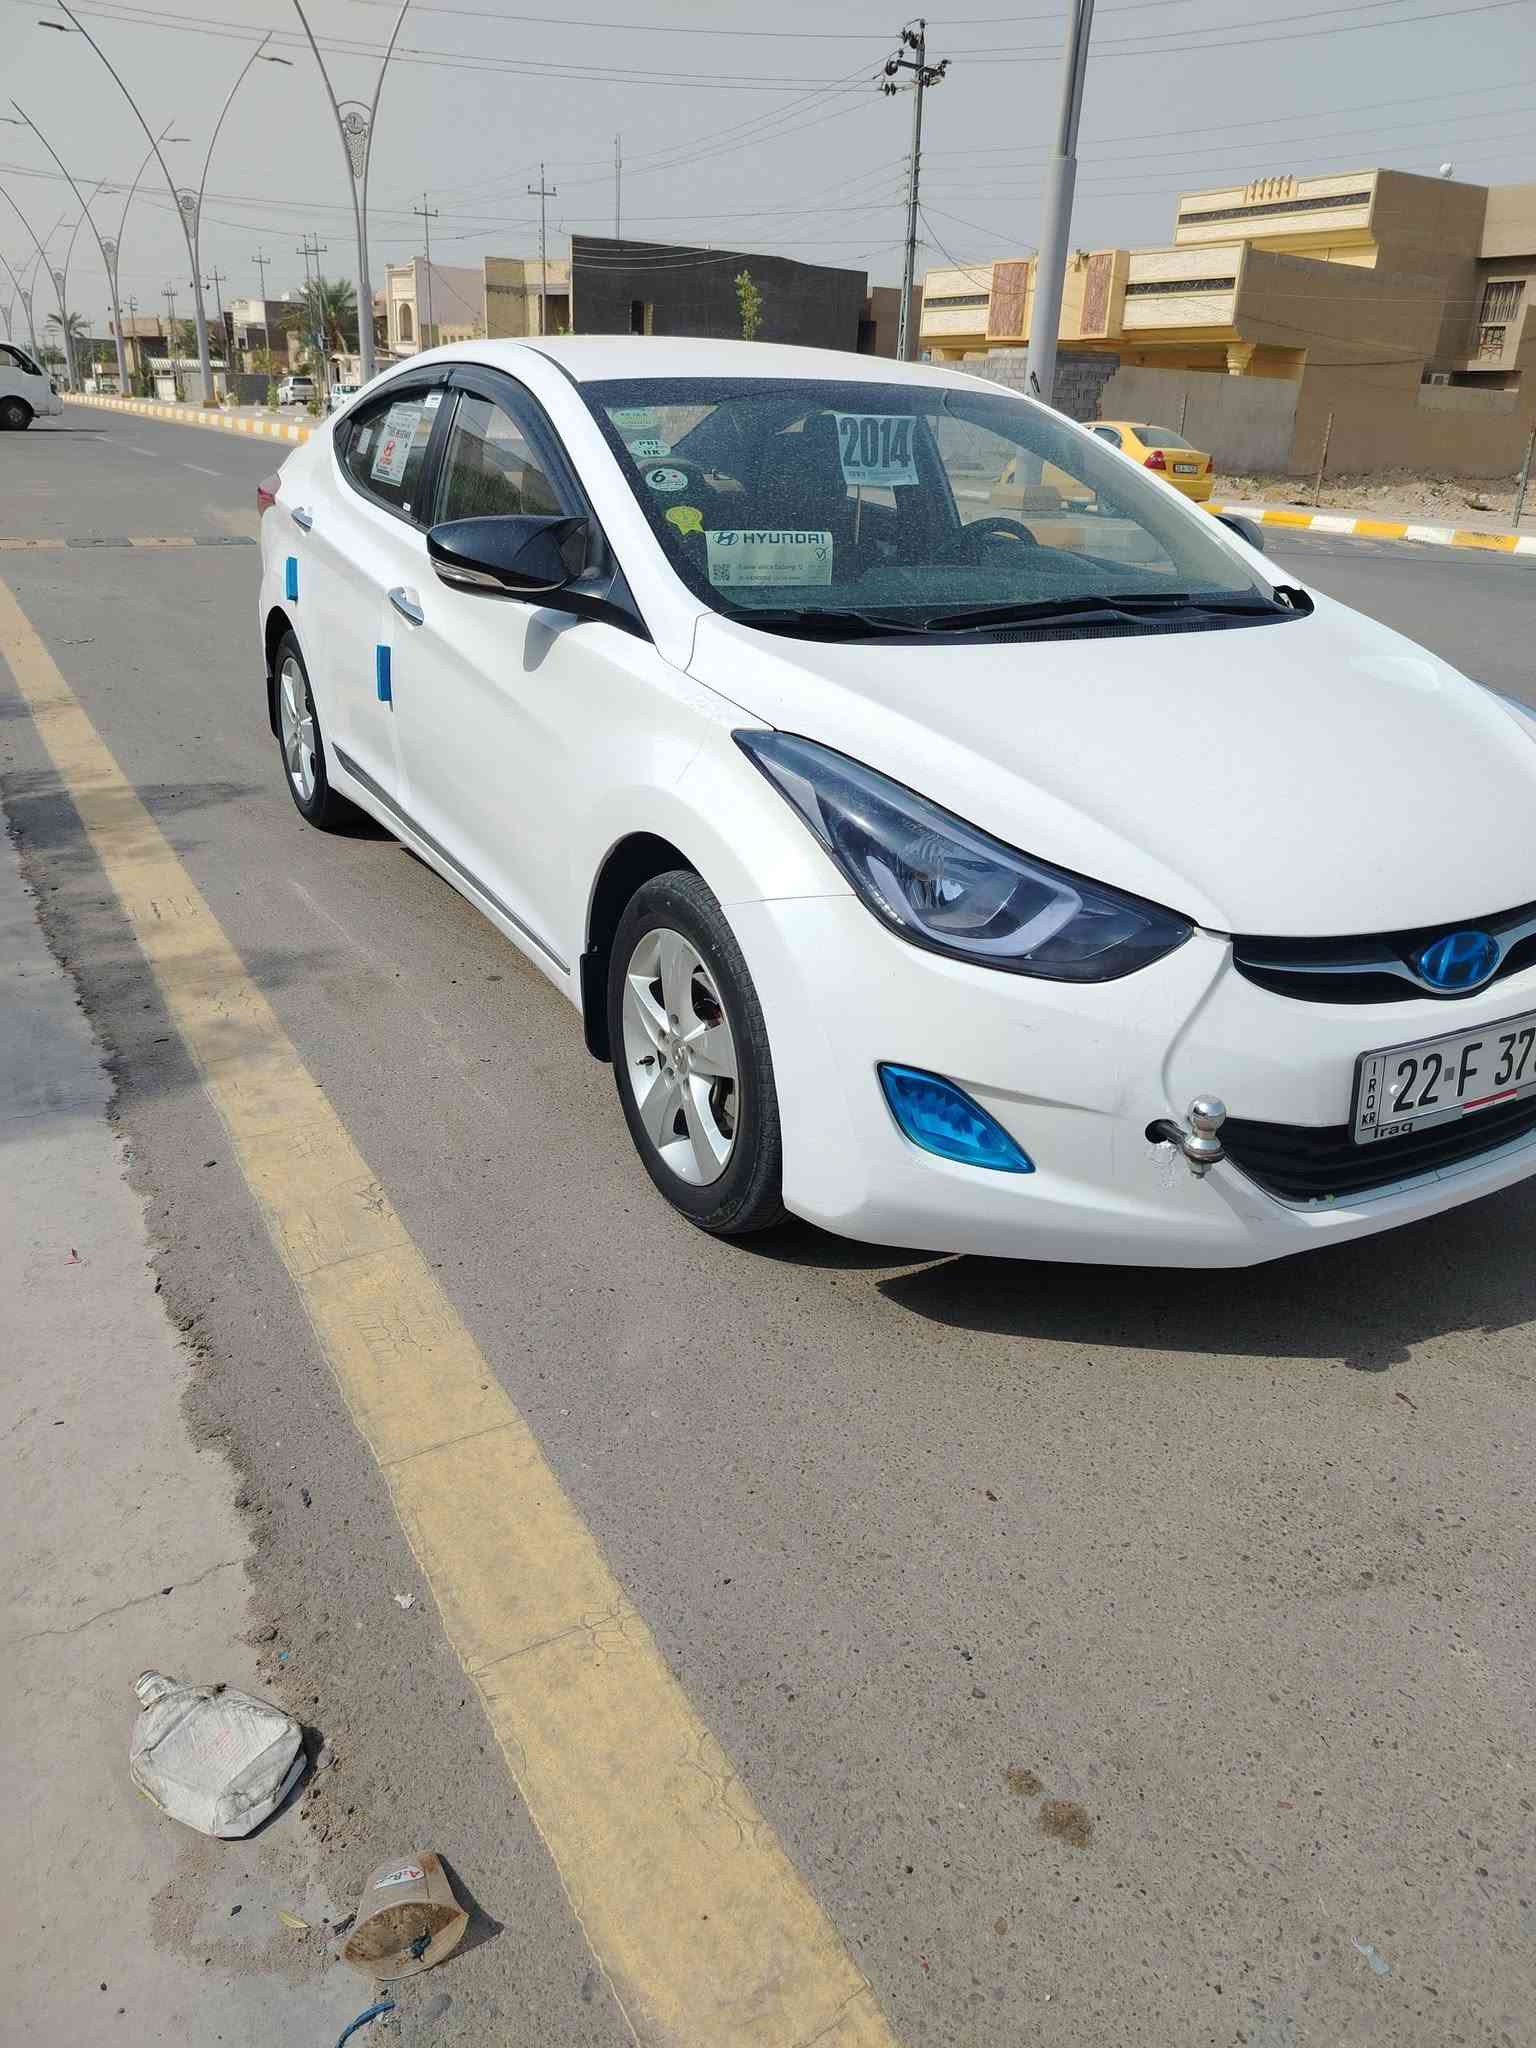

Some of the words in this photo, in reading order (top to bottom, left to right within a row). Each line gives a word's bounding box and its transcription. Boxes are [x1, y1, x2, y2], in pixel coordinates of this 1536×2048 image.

[840, 416, 912, 468] 2014
[651, 470, 666, 483] 6
[743, 532, 825, 544] HYUNDAI
[1392, 1053, 1443, 1113] 22
[1456, 1042, 1483, 1097] F
[1494, 1027, 1536, 1086] 37
[1374, 1122, 1414, 1139] Iraq
